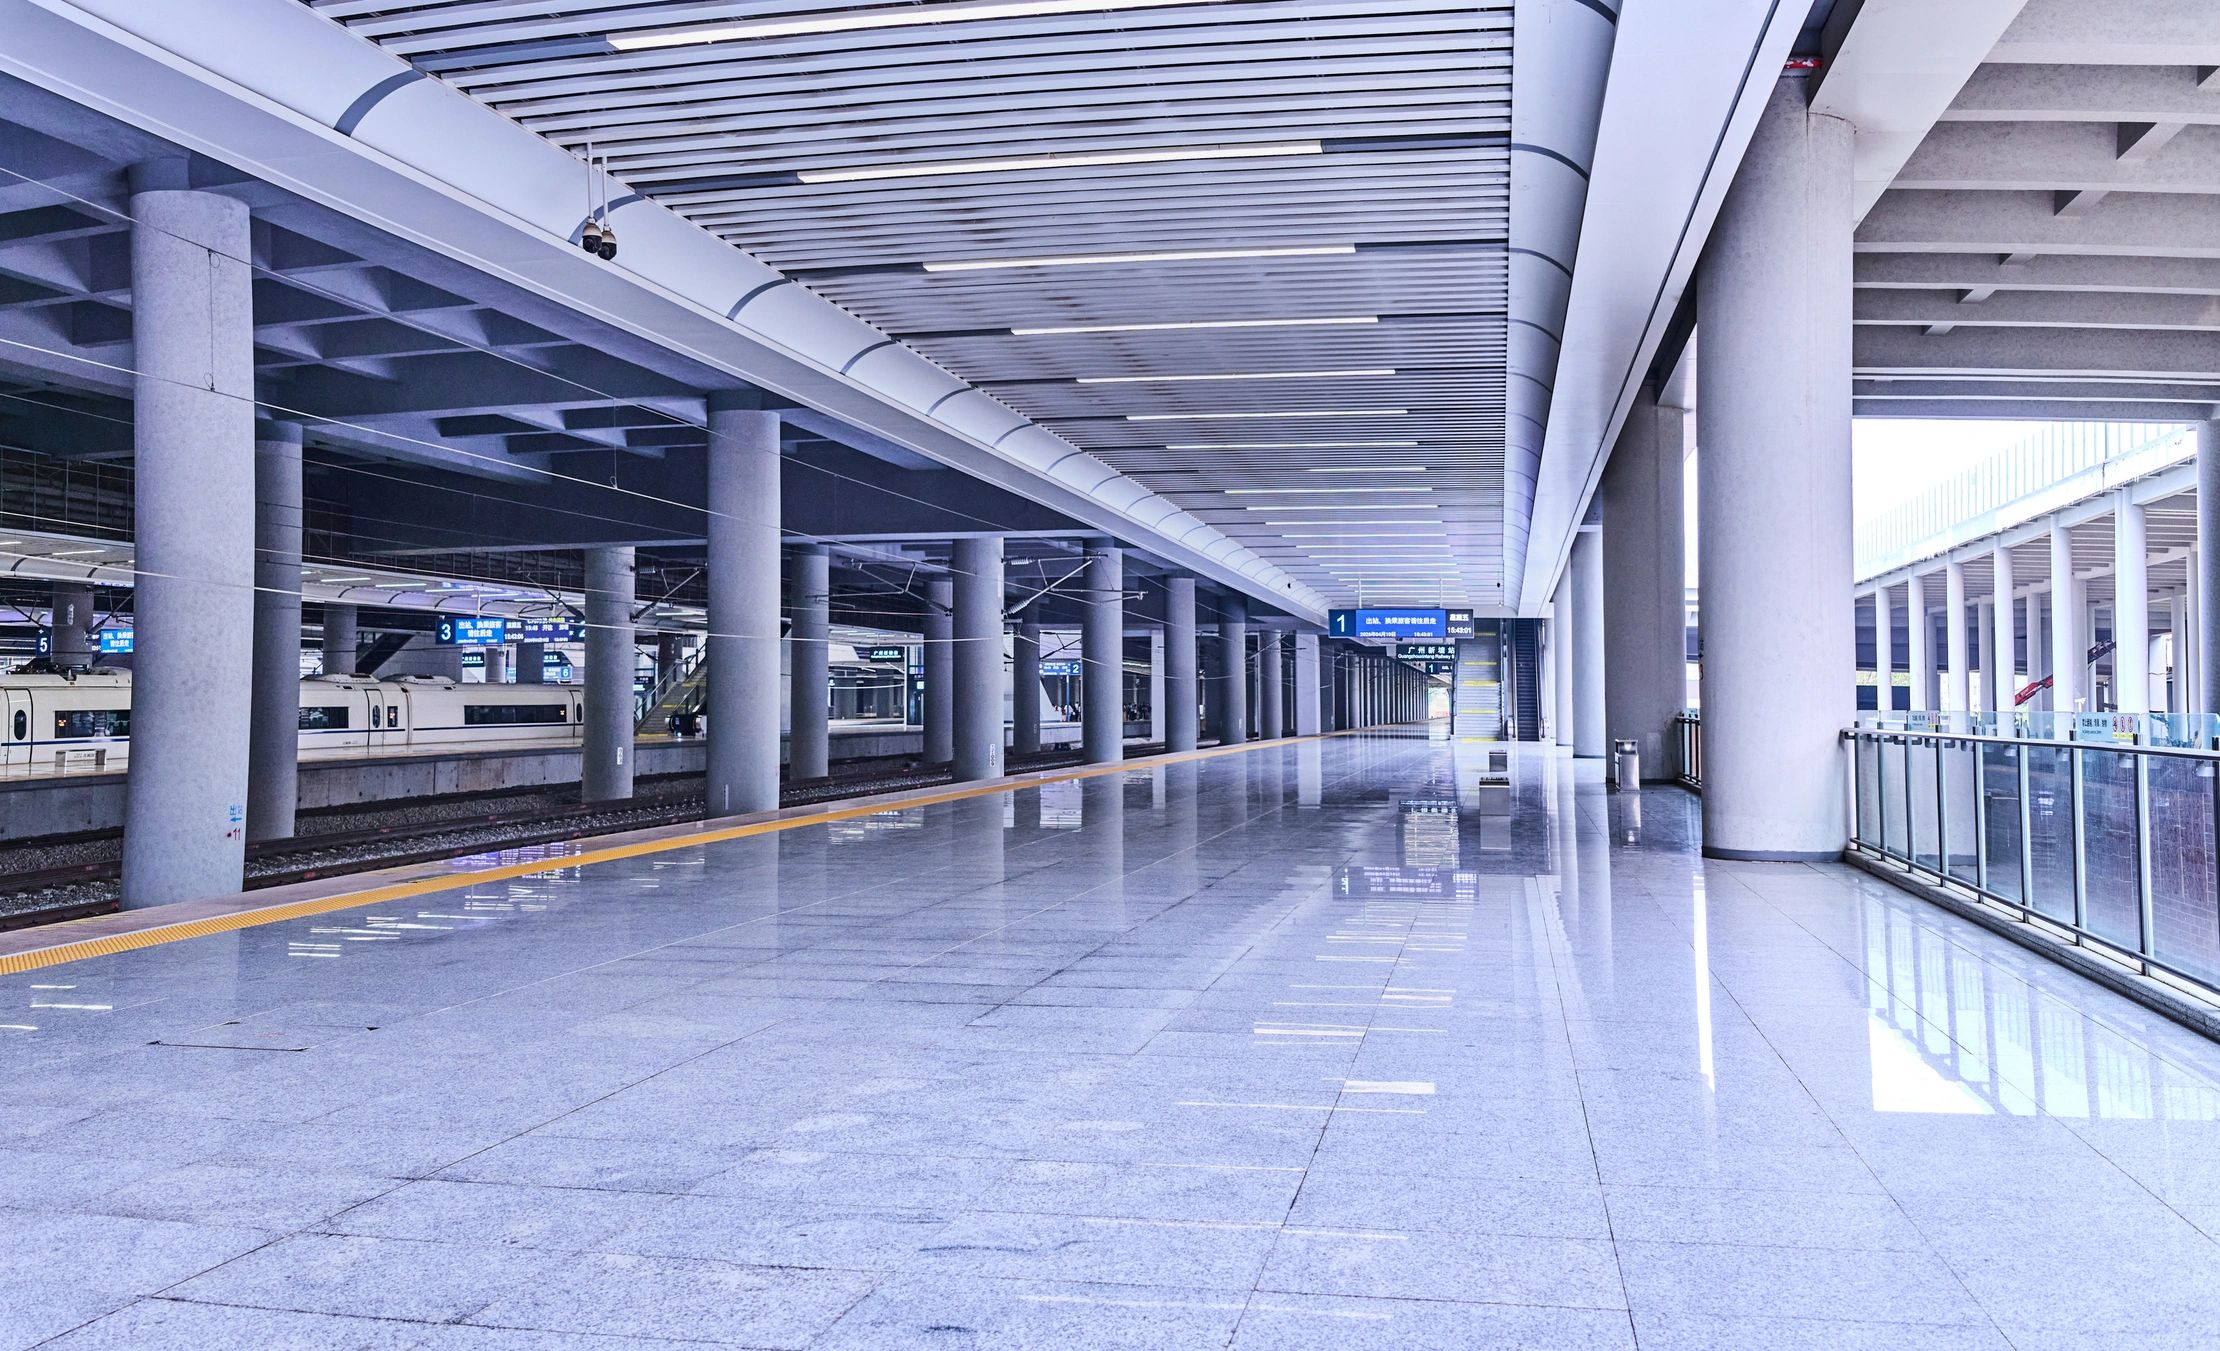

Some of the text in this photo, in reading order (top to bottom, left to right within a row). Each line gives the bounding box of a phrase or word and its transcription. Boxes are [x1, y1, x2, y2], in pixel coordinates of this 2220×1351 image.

[1336, 614, 1345, 632] 1
[441, 623, 451, 640] 3
[40, 637, 48, 653] 5
[1072, 664, 1079, 673] 2
[1428, 663, 1434, 673] 1
